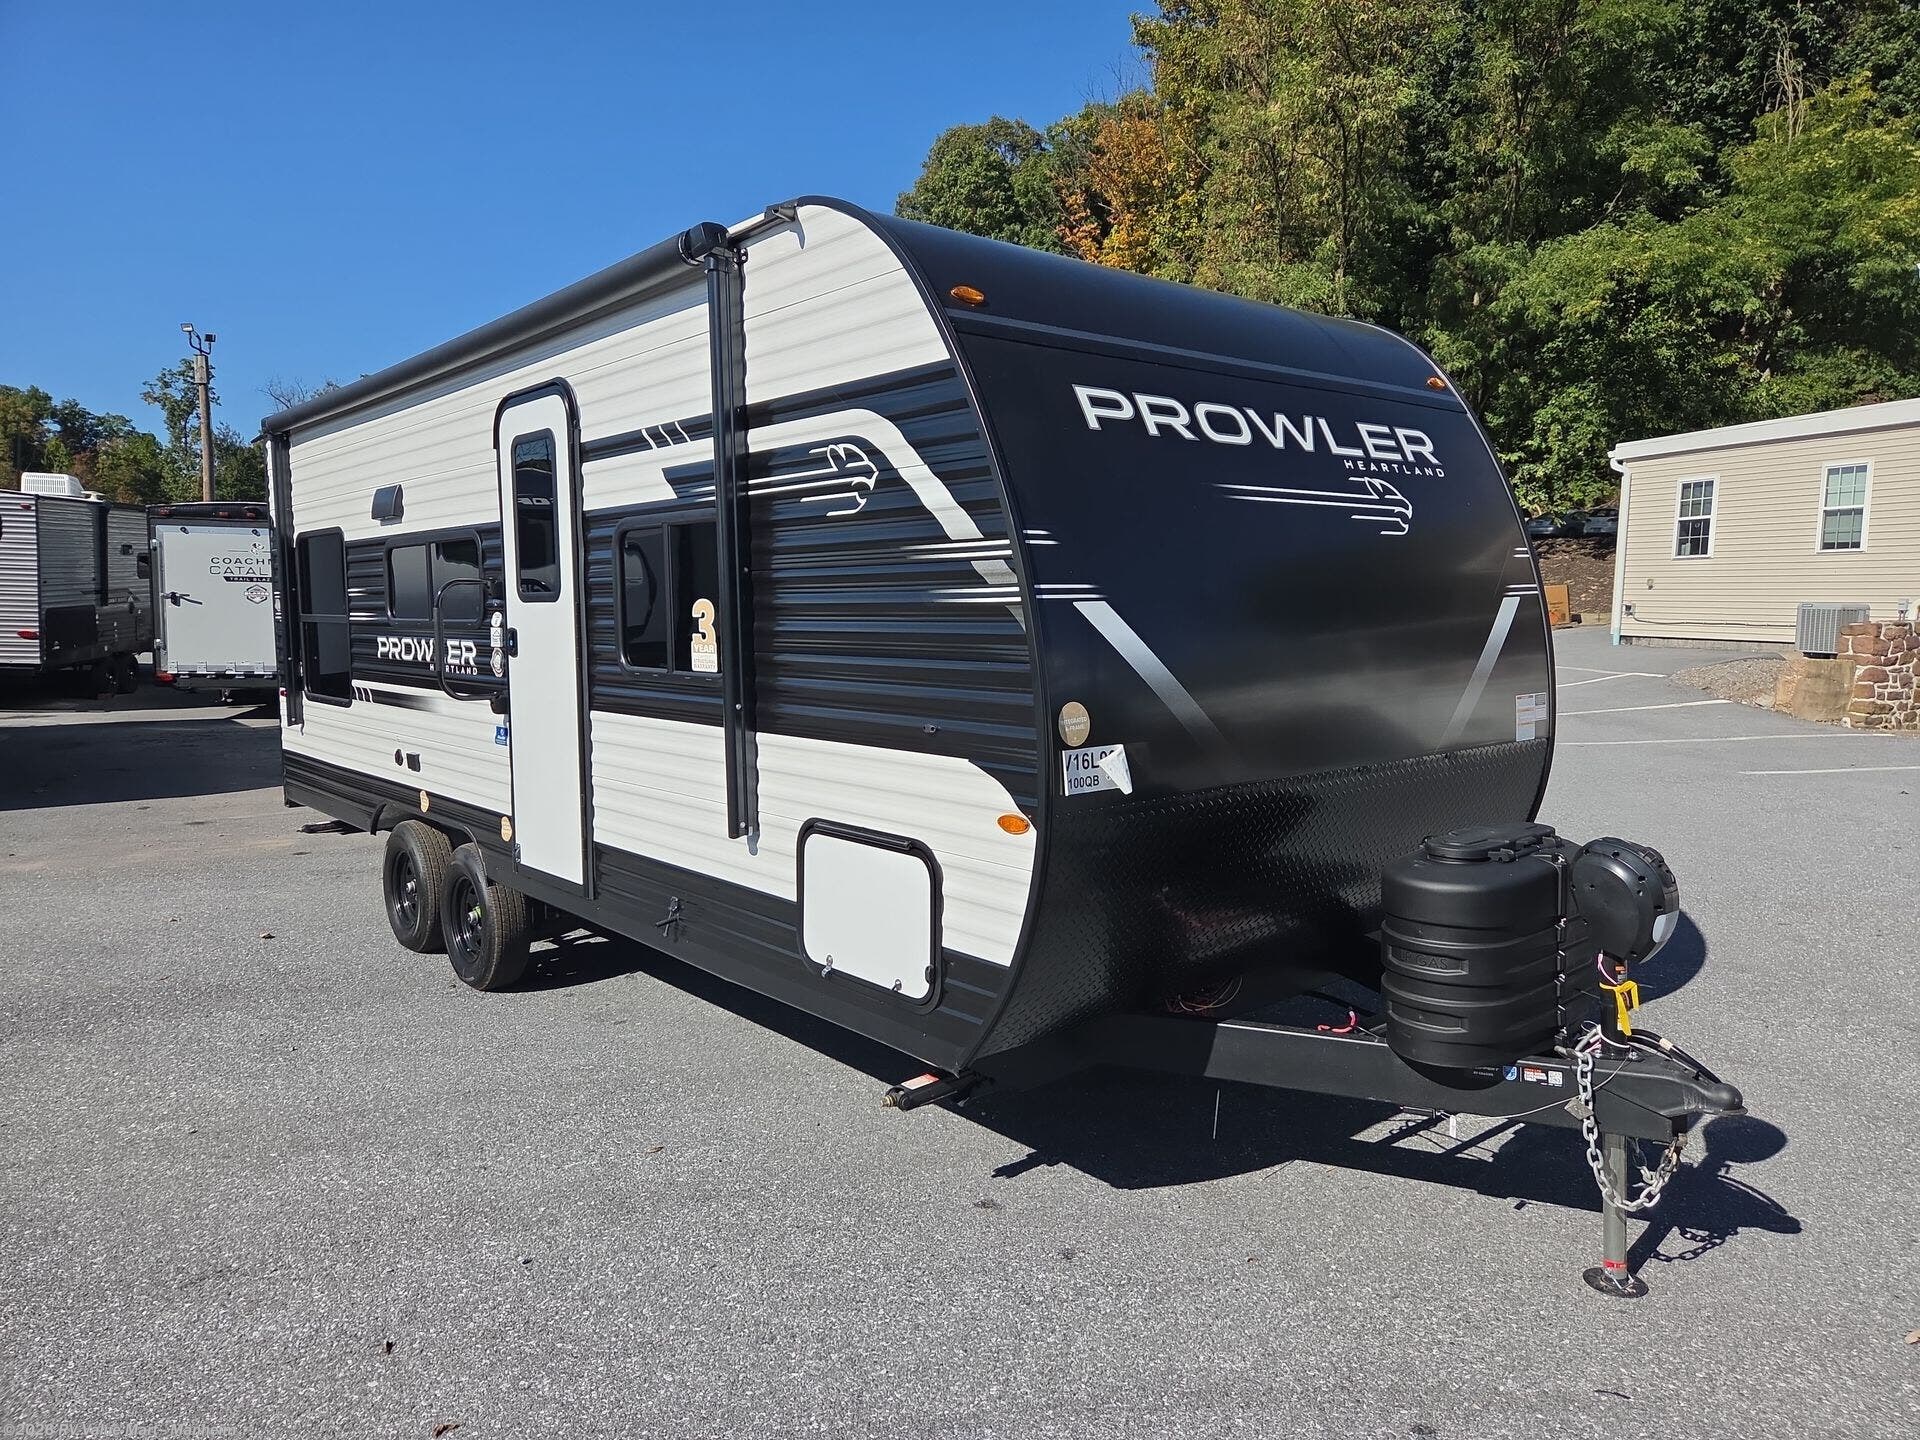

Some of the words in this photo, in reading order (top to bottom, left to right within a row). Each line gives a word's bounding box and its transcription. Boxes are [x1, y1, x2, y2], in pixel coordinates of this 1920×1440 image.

[1072, 384, 1443, 465] PROWLER
[1343, 459, 1445, 478] HEARTLAND
[692, 598, 716, 645] 3
[377, 636, 477, 666] PROWER
[693, 644, 715, 654] YEAR
[429, 664, 478, 676] HRTLAND
[1068, 775, 1100, 789] 100QB
[1415, 954, 1448, 970] GAS
